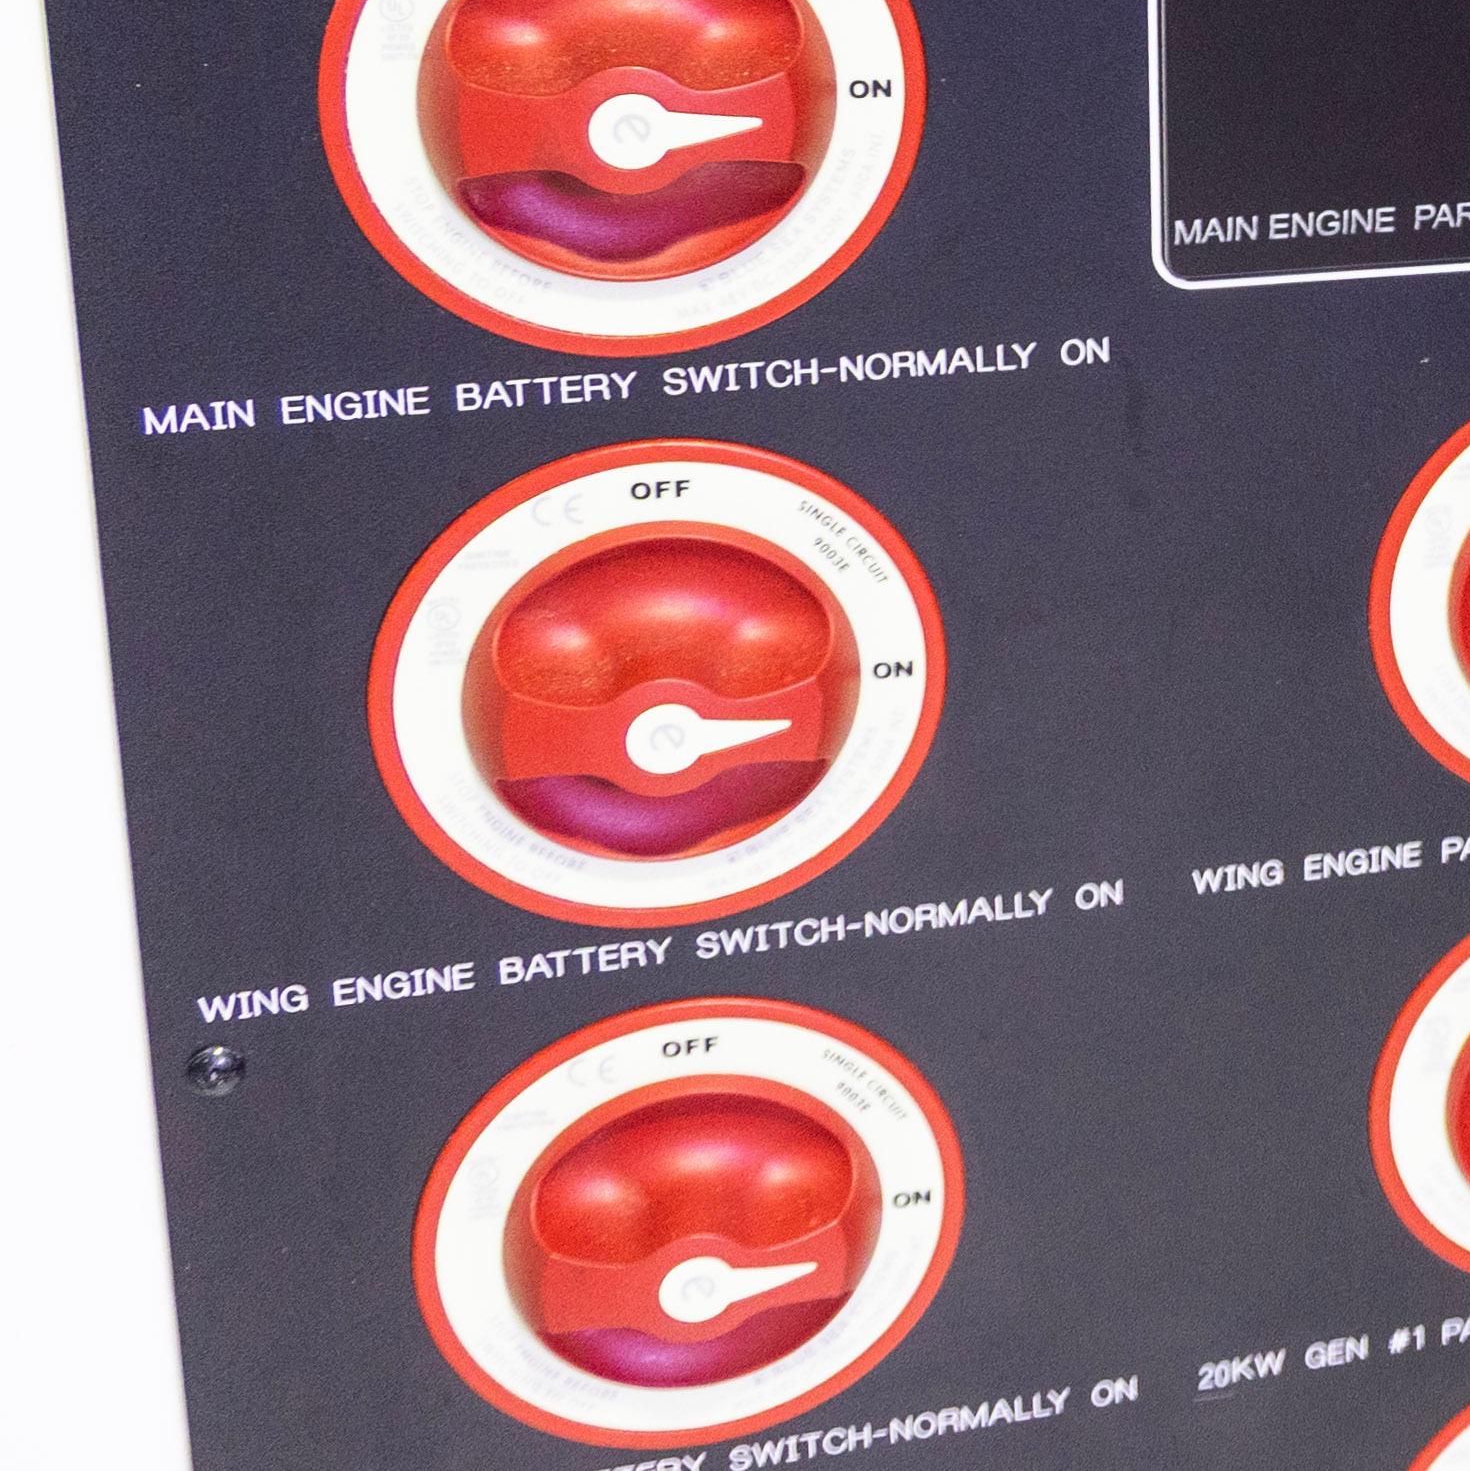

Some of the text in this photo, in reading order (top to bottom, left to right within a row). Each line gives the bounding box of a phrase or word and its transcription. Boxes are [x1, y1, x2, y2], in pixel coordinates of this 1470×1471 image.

[847, 78, 893, 101] ON
[1174, 215, 1259, 245] MAIN
[1268, 206, 1396, 240] ENGINE
[142, 336, 1110, 436] MAIN ENGINE BATTERY SWITCH-NORMALLY ON
[628, 478, 692, 502] OFF
[798, 499, 889, 585] SINGLE CIRCUIT
[812, 536, 851, 573] 9003E
[871, 659, 915, 681] ON
[1191, 859, 1285, 895] WING
[1303, 840, 1422, 882] ENGINE
[196, 879, 1124, 1024] WING ENGINE BATTERY SWITCH-NORMALLY ON
[660, 1035, 719, 1059] OFF
[891, 1188, 933, 1209] ON
[1198, 1348, 1286, 1391] 20KW
[1304, 1336, 1369, 1369] GEN
[1387, 1325, 1426, 1355] #1
[728, 1375, 1139, 1471] SWITCH-NORMALLY ON
